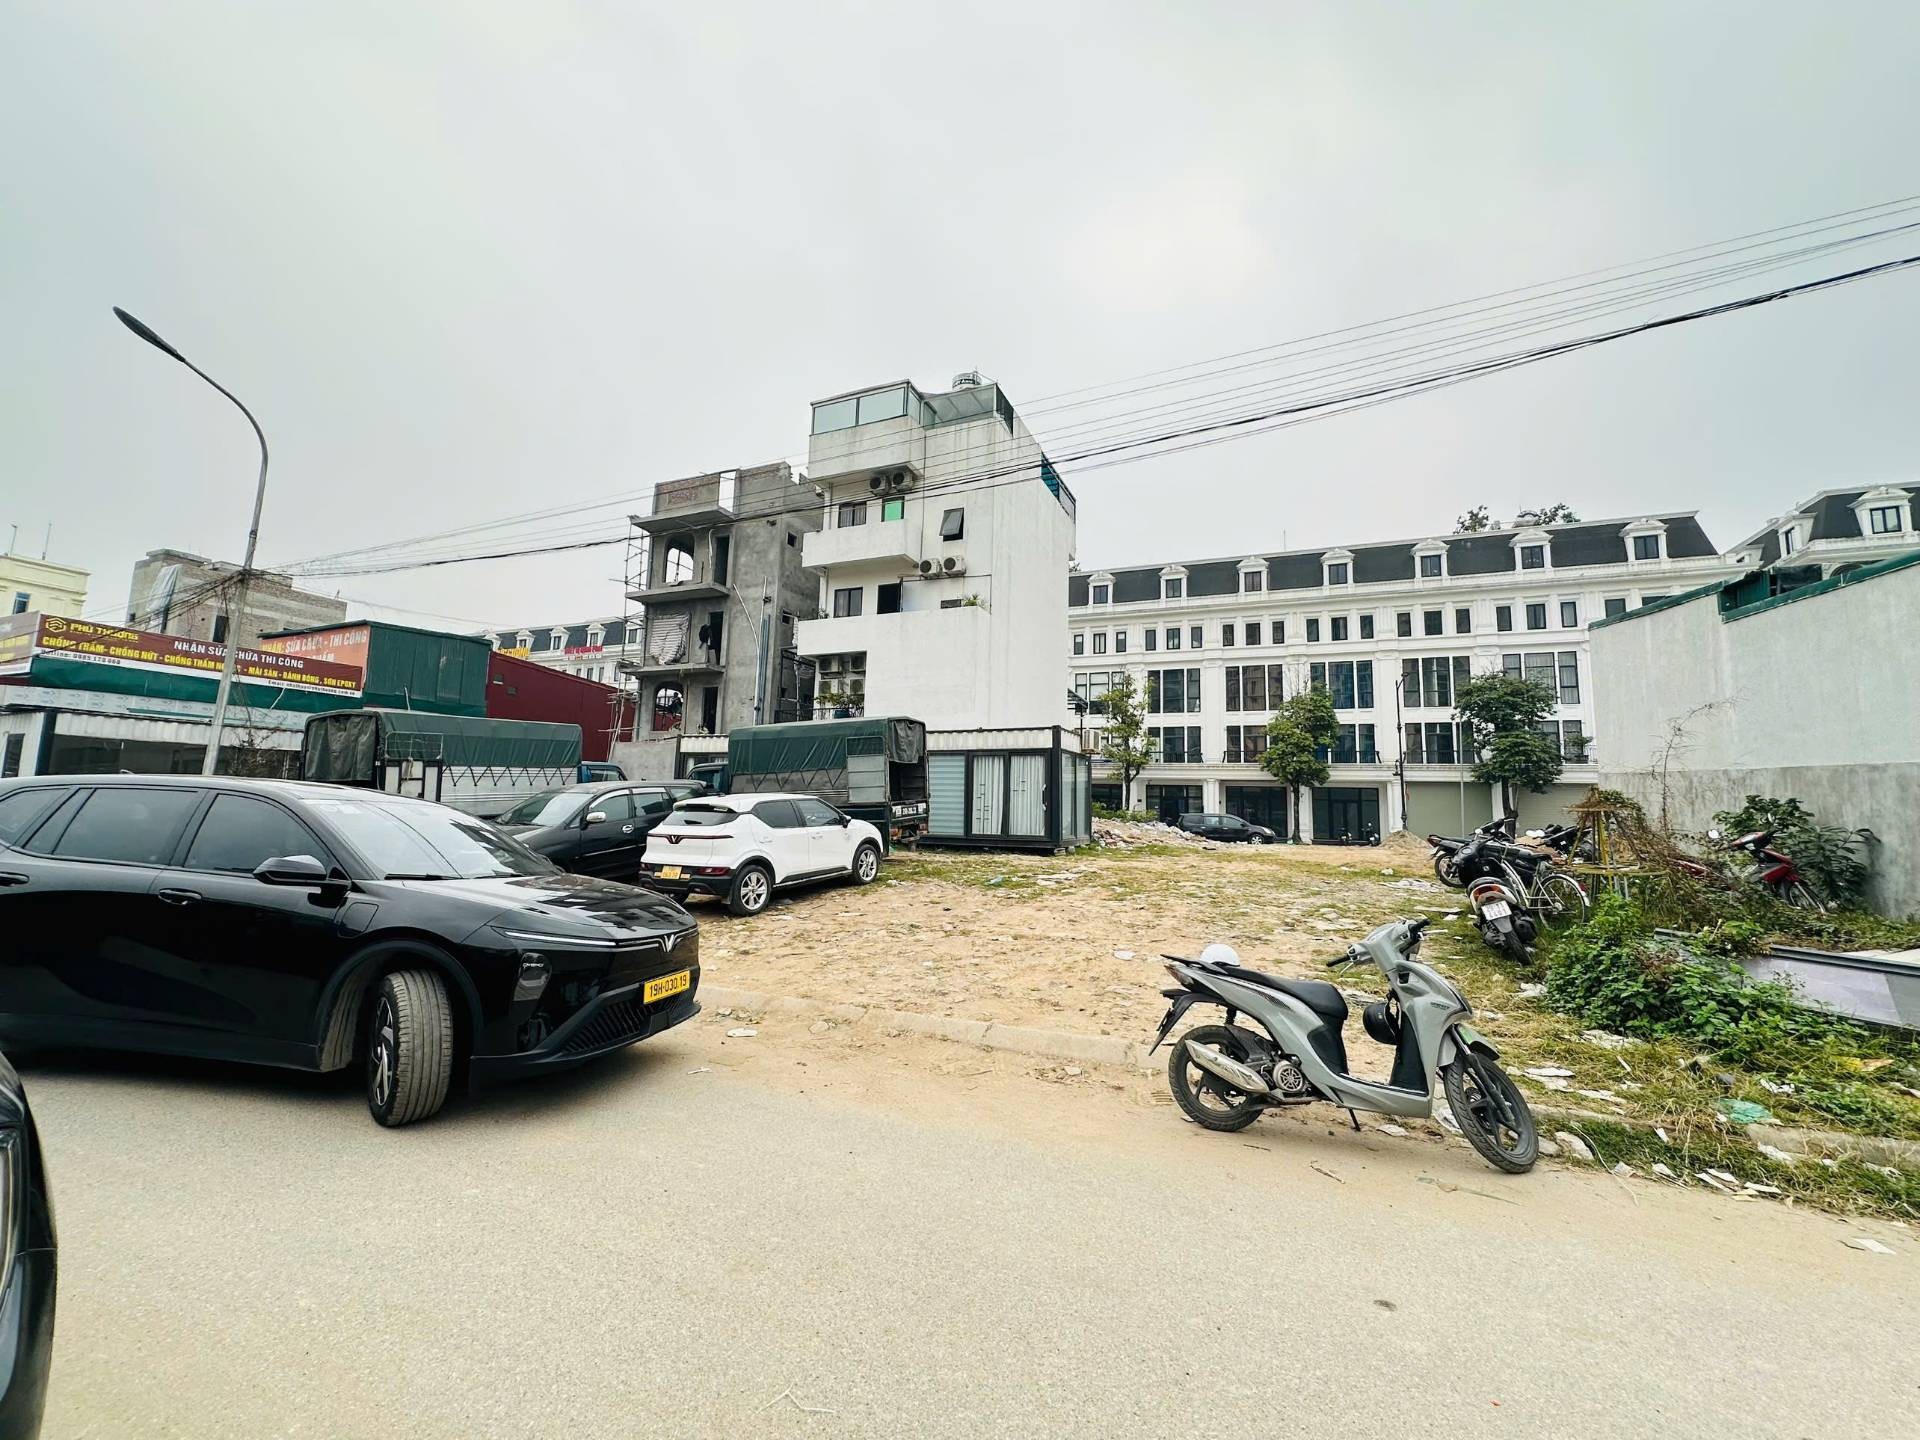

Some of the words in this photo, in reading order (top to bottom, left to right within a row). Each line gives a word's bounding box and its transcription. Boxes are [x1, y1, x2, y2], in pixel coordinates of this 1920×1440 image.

[329, 633, 343, 648] THI
[343, 629, 367, 645] CÔNG
[109, 645, 140, 658] CHỐNG
[164, 653, 192, 666] CHỐNG
[193, 657, 215, 670] THẤM
[174, 640, 206, 654] NHẬN
[235, 650, 258, 662] HỮA
[260, 654, 275, 665] THI
[278, 656, 304, 669] CÔNG
